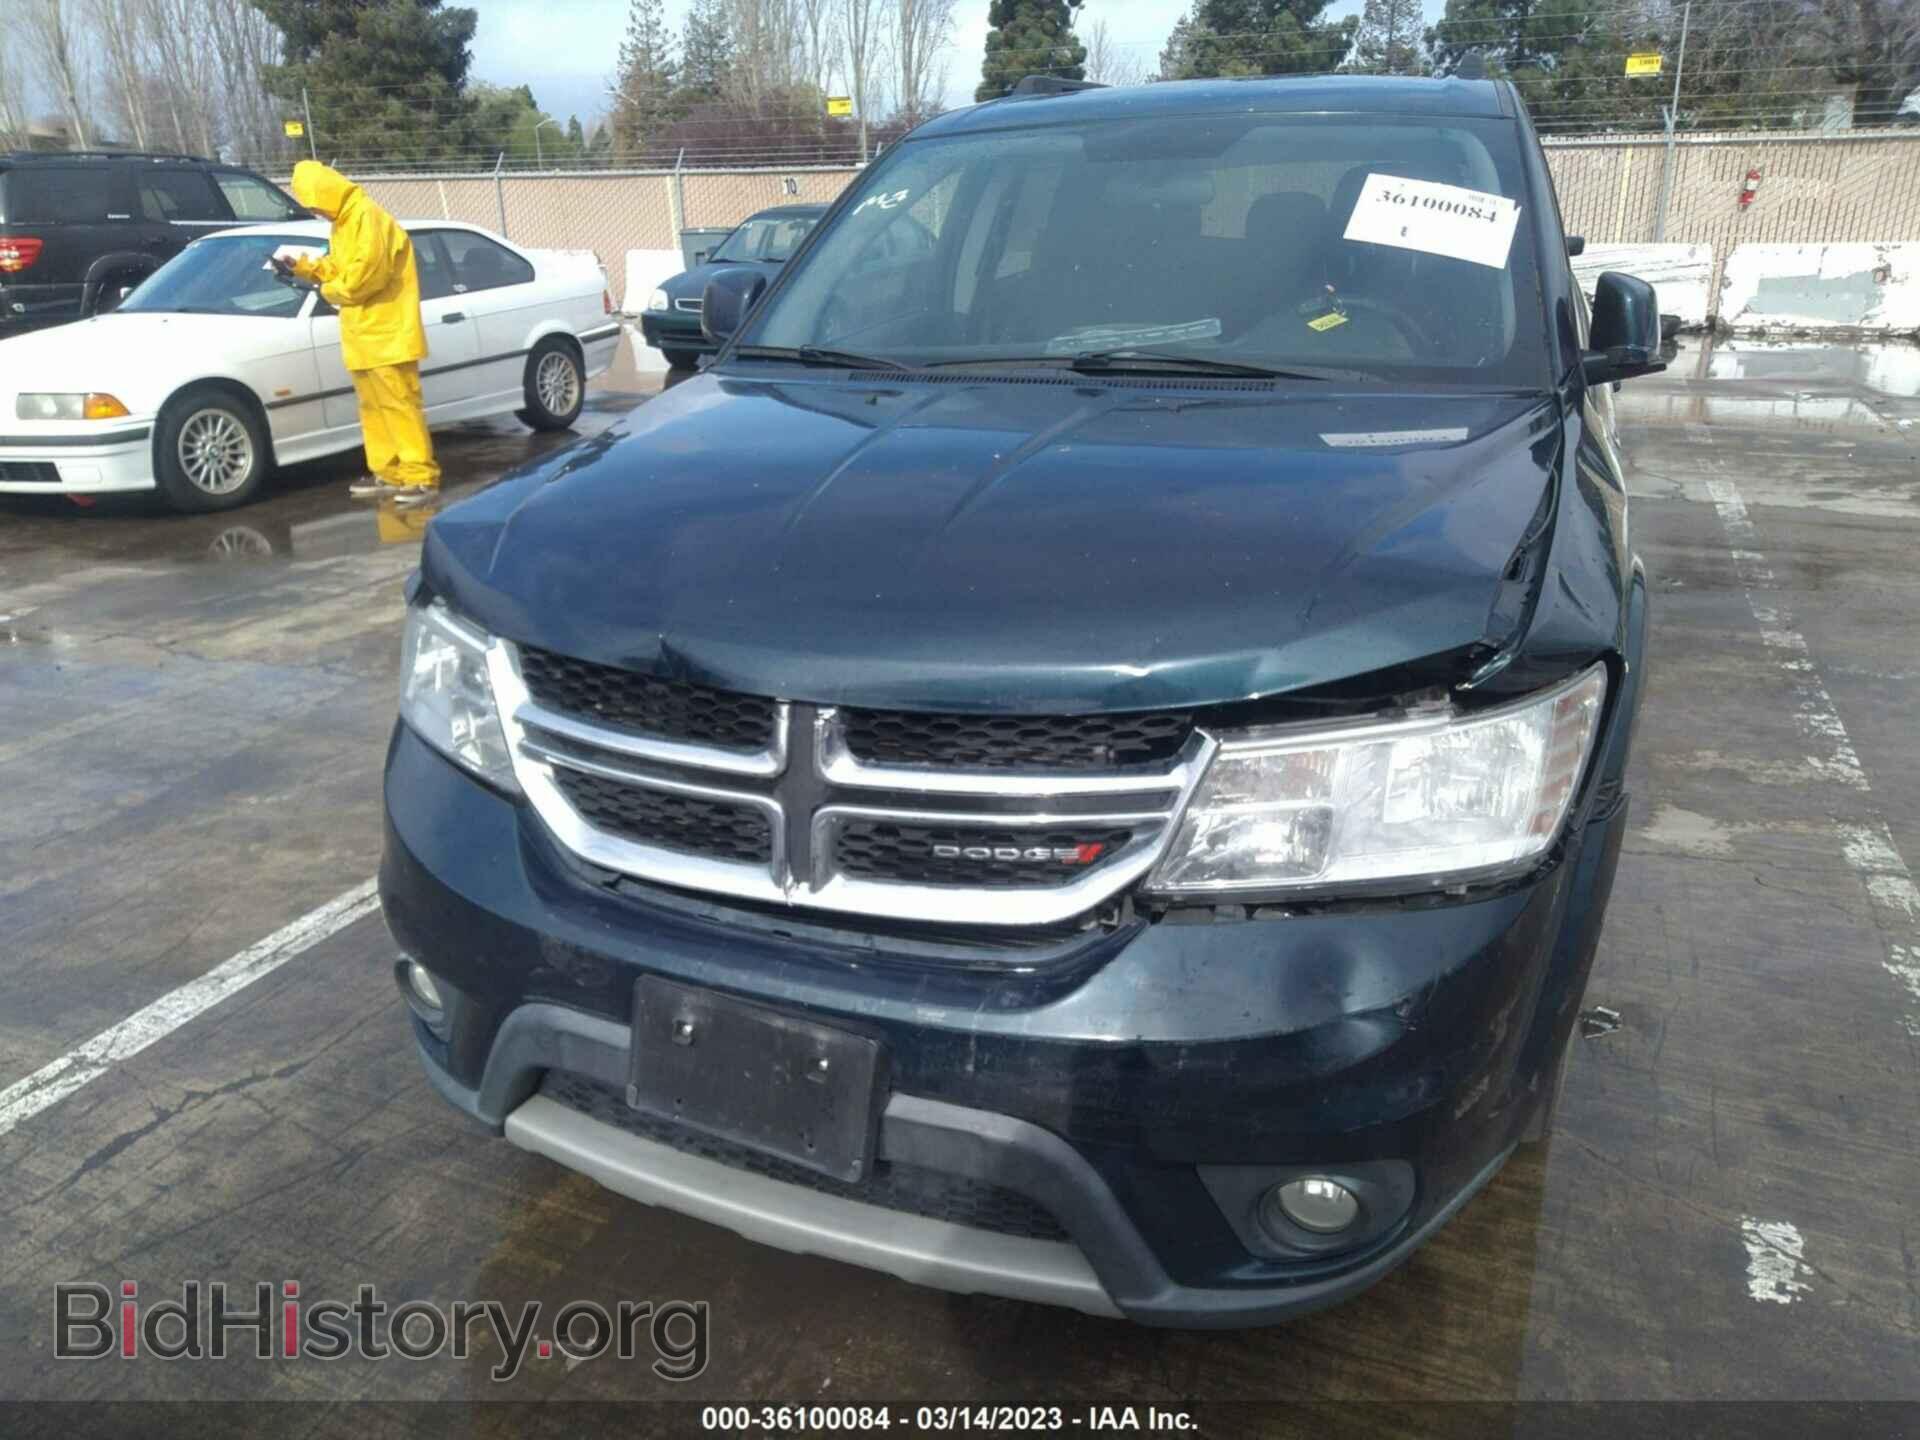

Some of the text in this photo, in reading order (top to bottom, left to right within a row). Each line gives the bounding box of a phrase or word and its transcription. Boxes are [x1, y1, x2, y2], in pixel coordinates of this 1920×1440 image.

[783, 177, 798, 194] 10
[1376, 190, 1497, 222] 36100084
[933, 844, 1080, 861] DODGE
